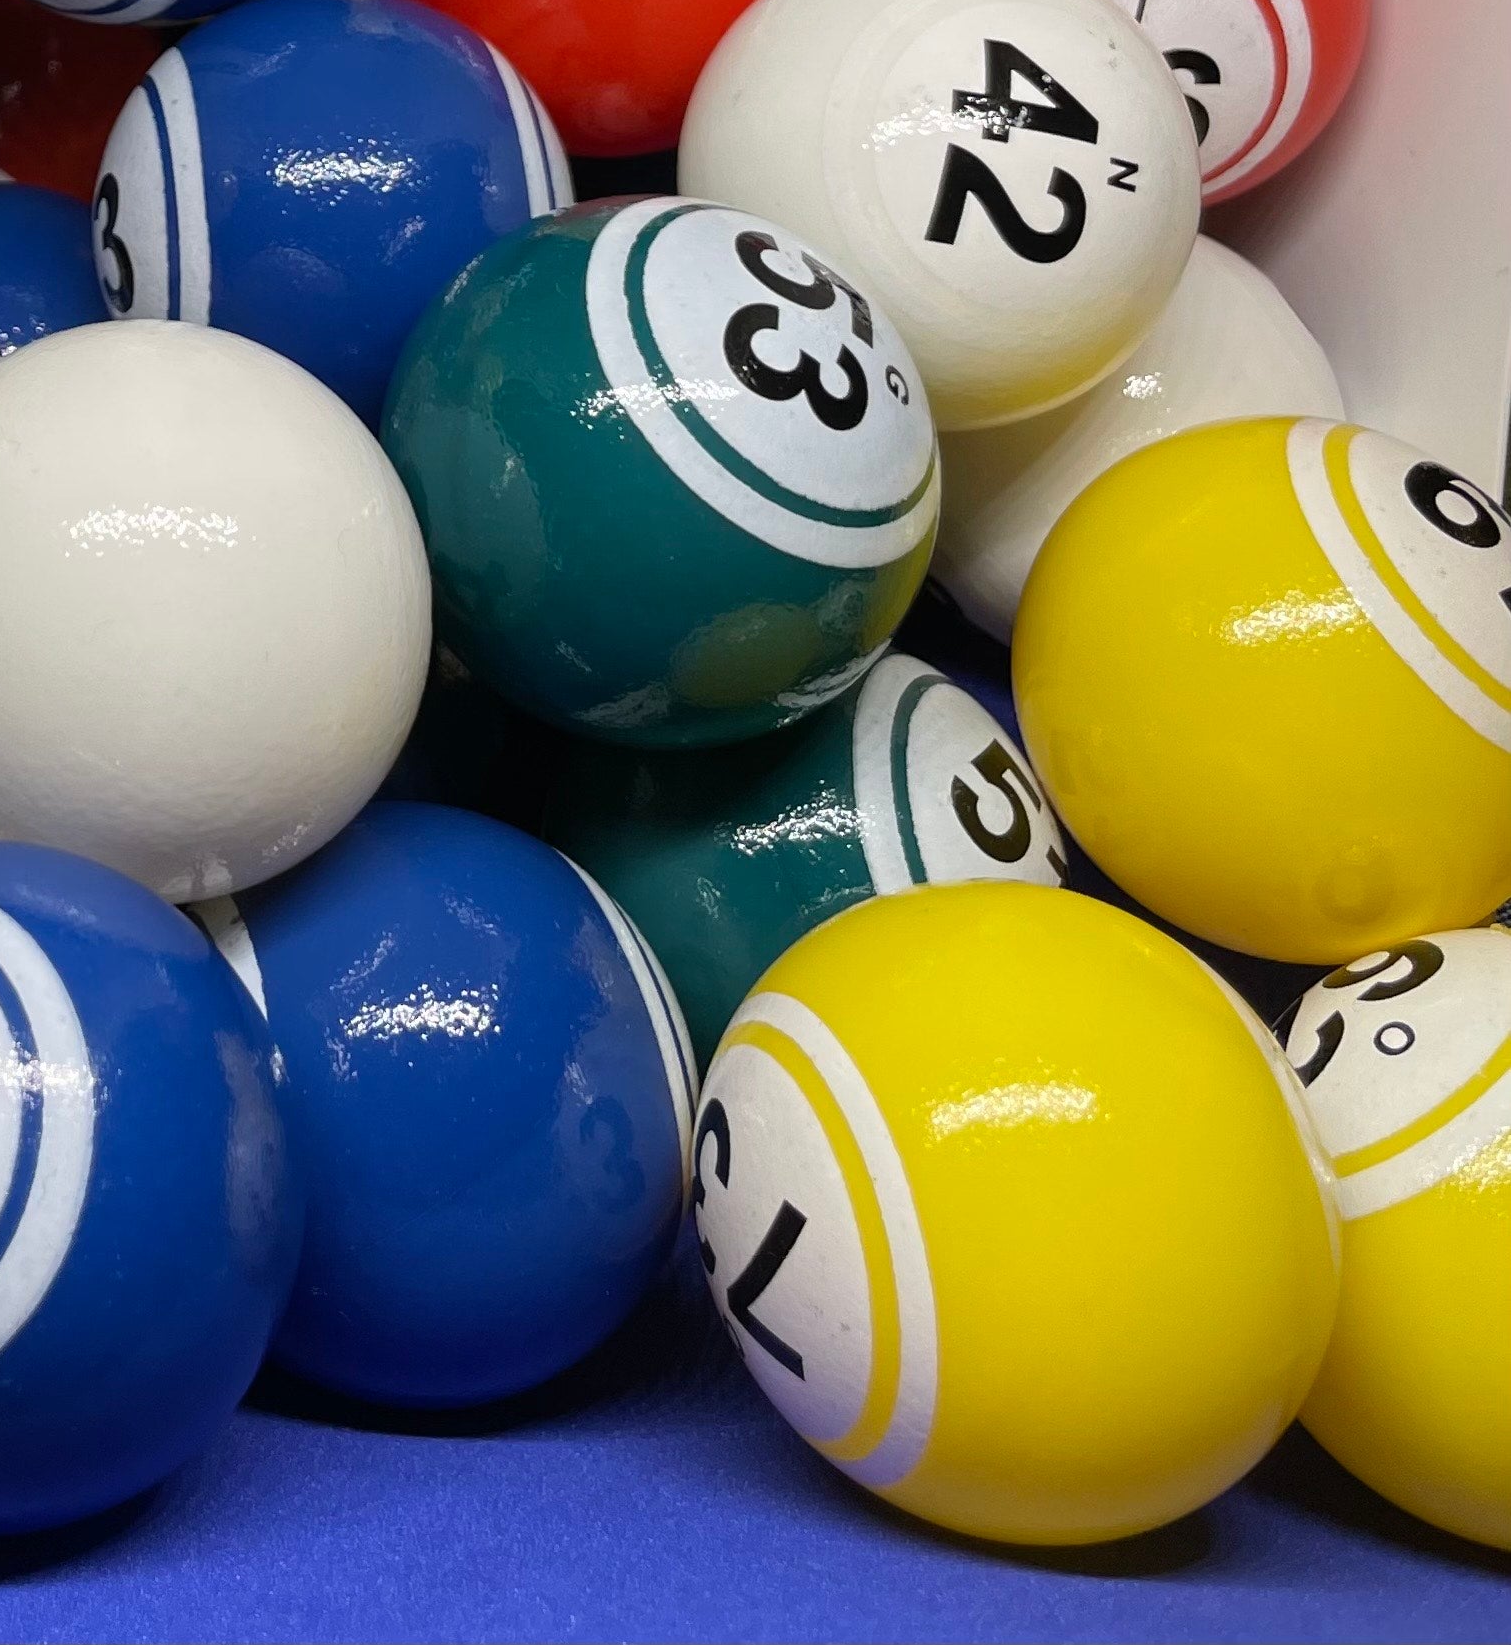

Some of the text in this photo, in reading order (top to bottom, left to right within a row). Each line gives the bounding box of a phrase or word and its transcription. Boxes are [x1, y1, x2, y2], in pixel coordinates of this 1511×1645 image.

[925, 38, 1098, 264] 42
[1107, 157, 1139, 192] N
[724, 230, 873, 431] 53
[885, 364, 909, 406] G
[1373, 1021, 1416, 1056] O
[692, 1096, 808, 1382] 73
